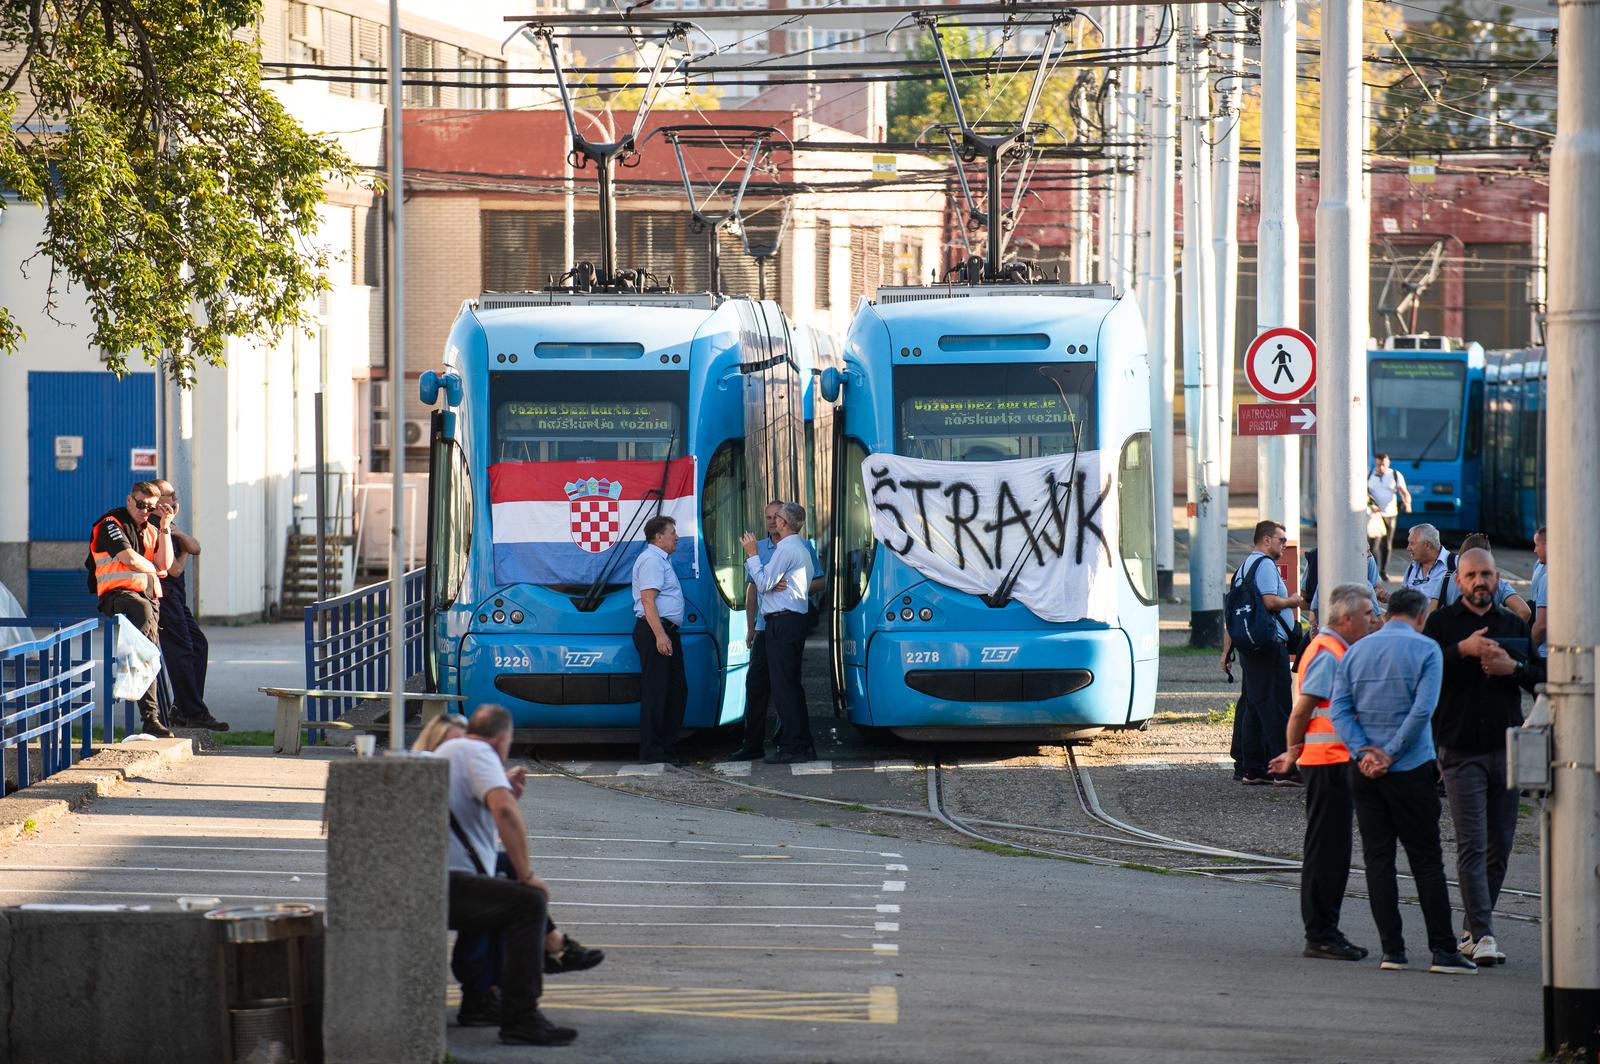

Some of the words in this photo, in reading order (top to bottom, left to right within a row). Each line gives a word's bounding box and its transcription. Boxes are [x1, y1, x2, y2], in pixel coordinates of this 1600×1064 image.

[559, 403, 589, 415] bez
[1241, 408, 1287, 419] VATROGASNI
[1249, 421, 1278, 431] PRISTUP
[871, 466, 1113, 570] ŠTRAJK
[565, 652, 603, 667] ZET
[906, 651, 940, 663] 2278
[981, 646, 1020, 662] ZET
[494, 656, 529, 667] 2226
